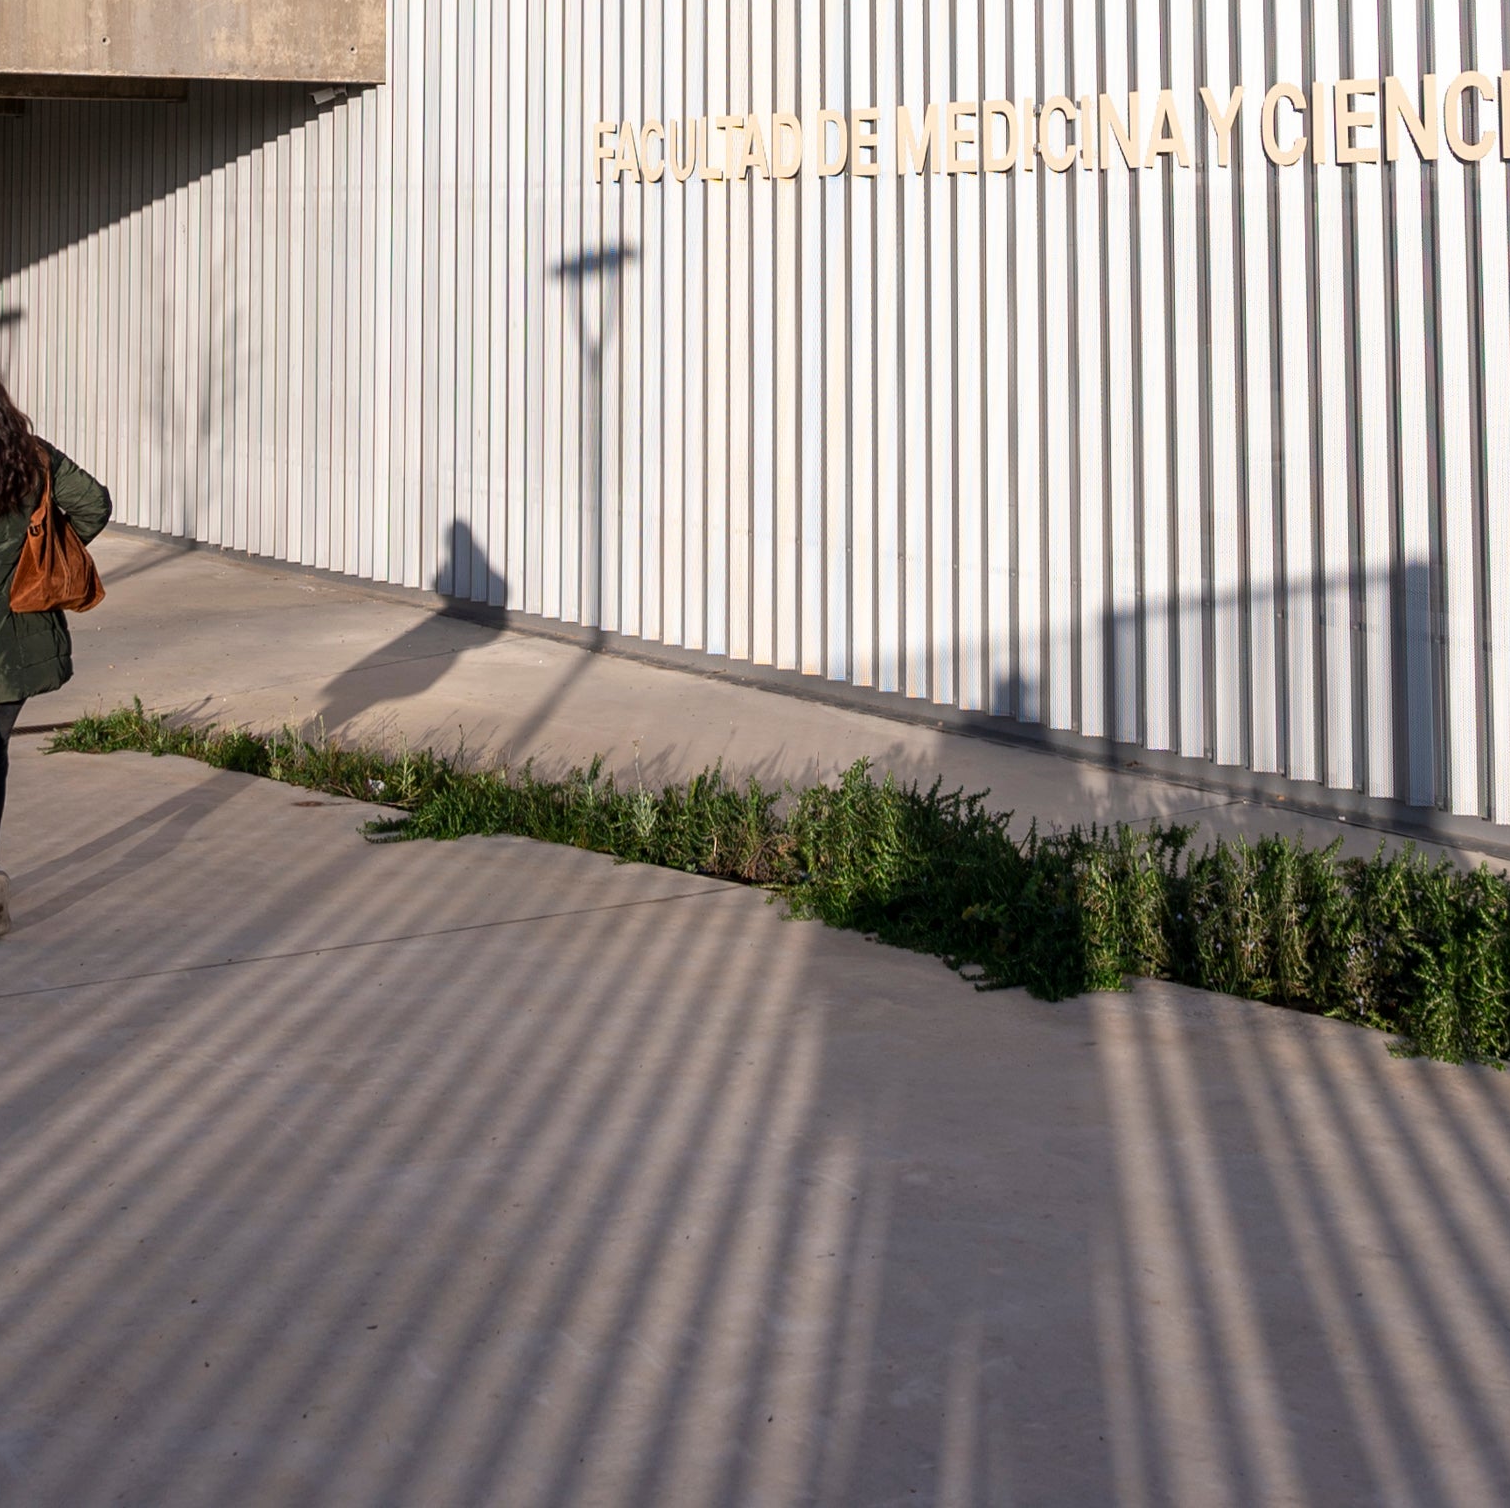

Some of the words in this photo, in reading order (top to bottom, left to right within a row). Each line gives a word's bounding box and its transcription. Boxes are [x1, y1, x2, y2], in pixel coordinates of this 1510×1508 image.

[592, 111, 803, 184] FACULTAD
[817, 106, 882, 177] DE
[897, 88, 1190, 176] MEDICINA
[1199, 85, 1245, 168] Y
